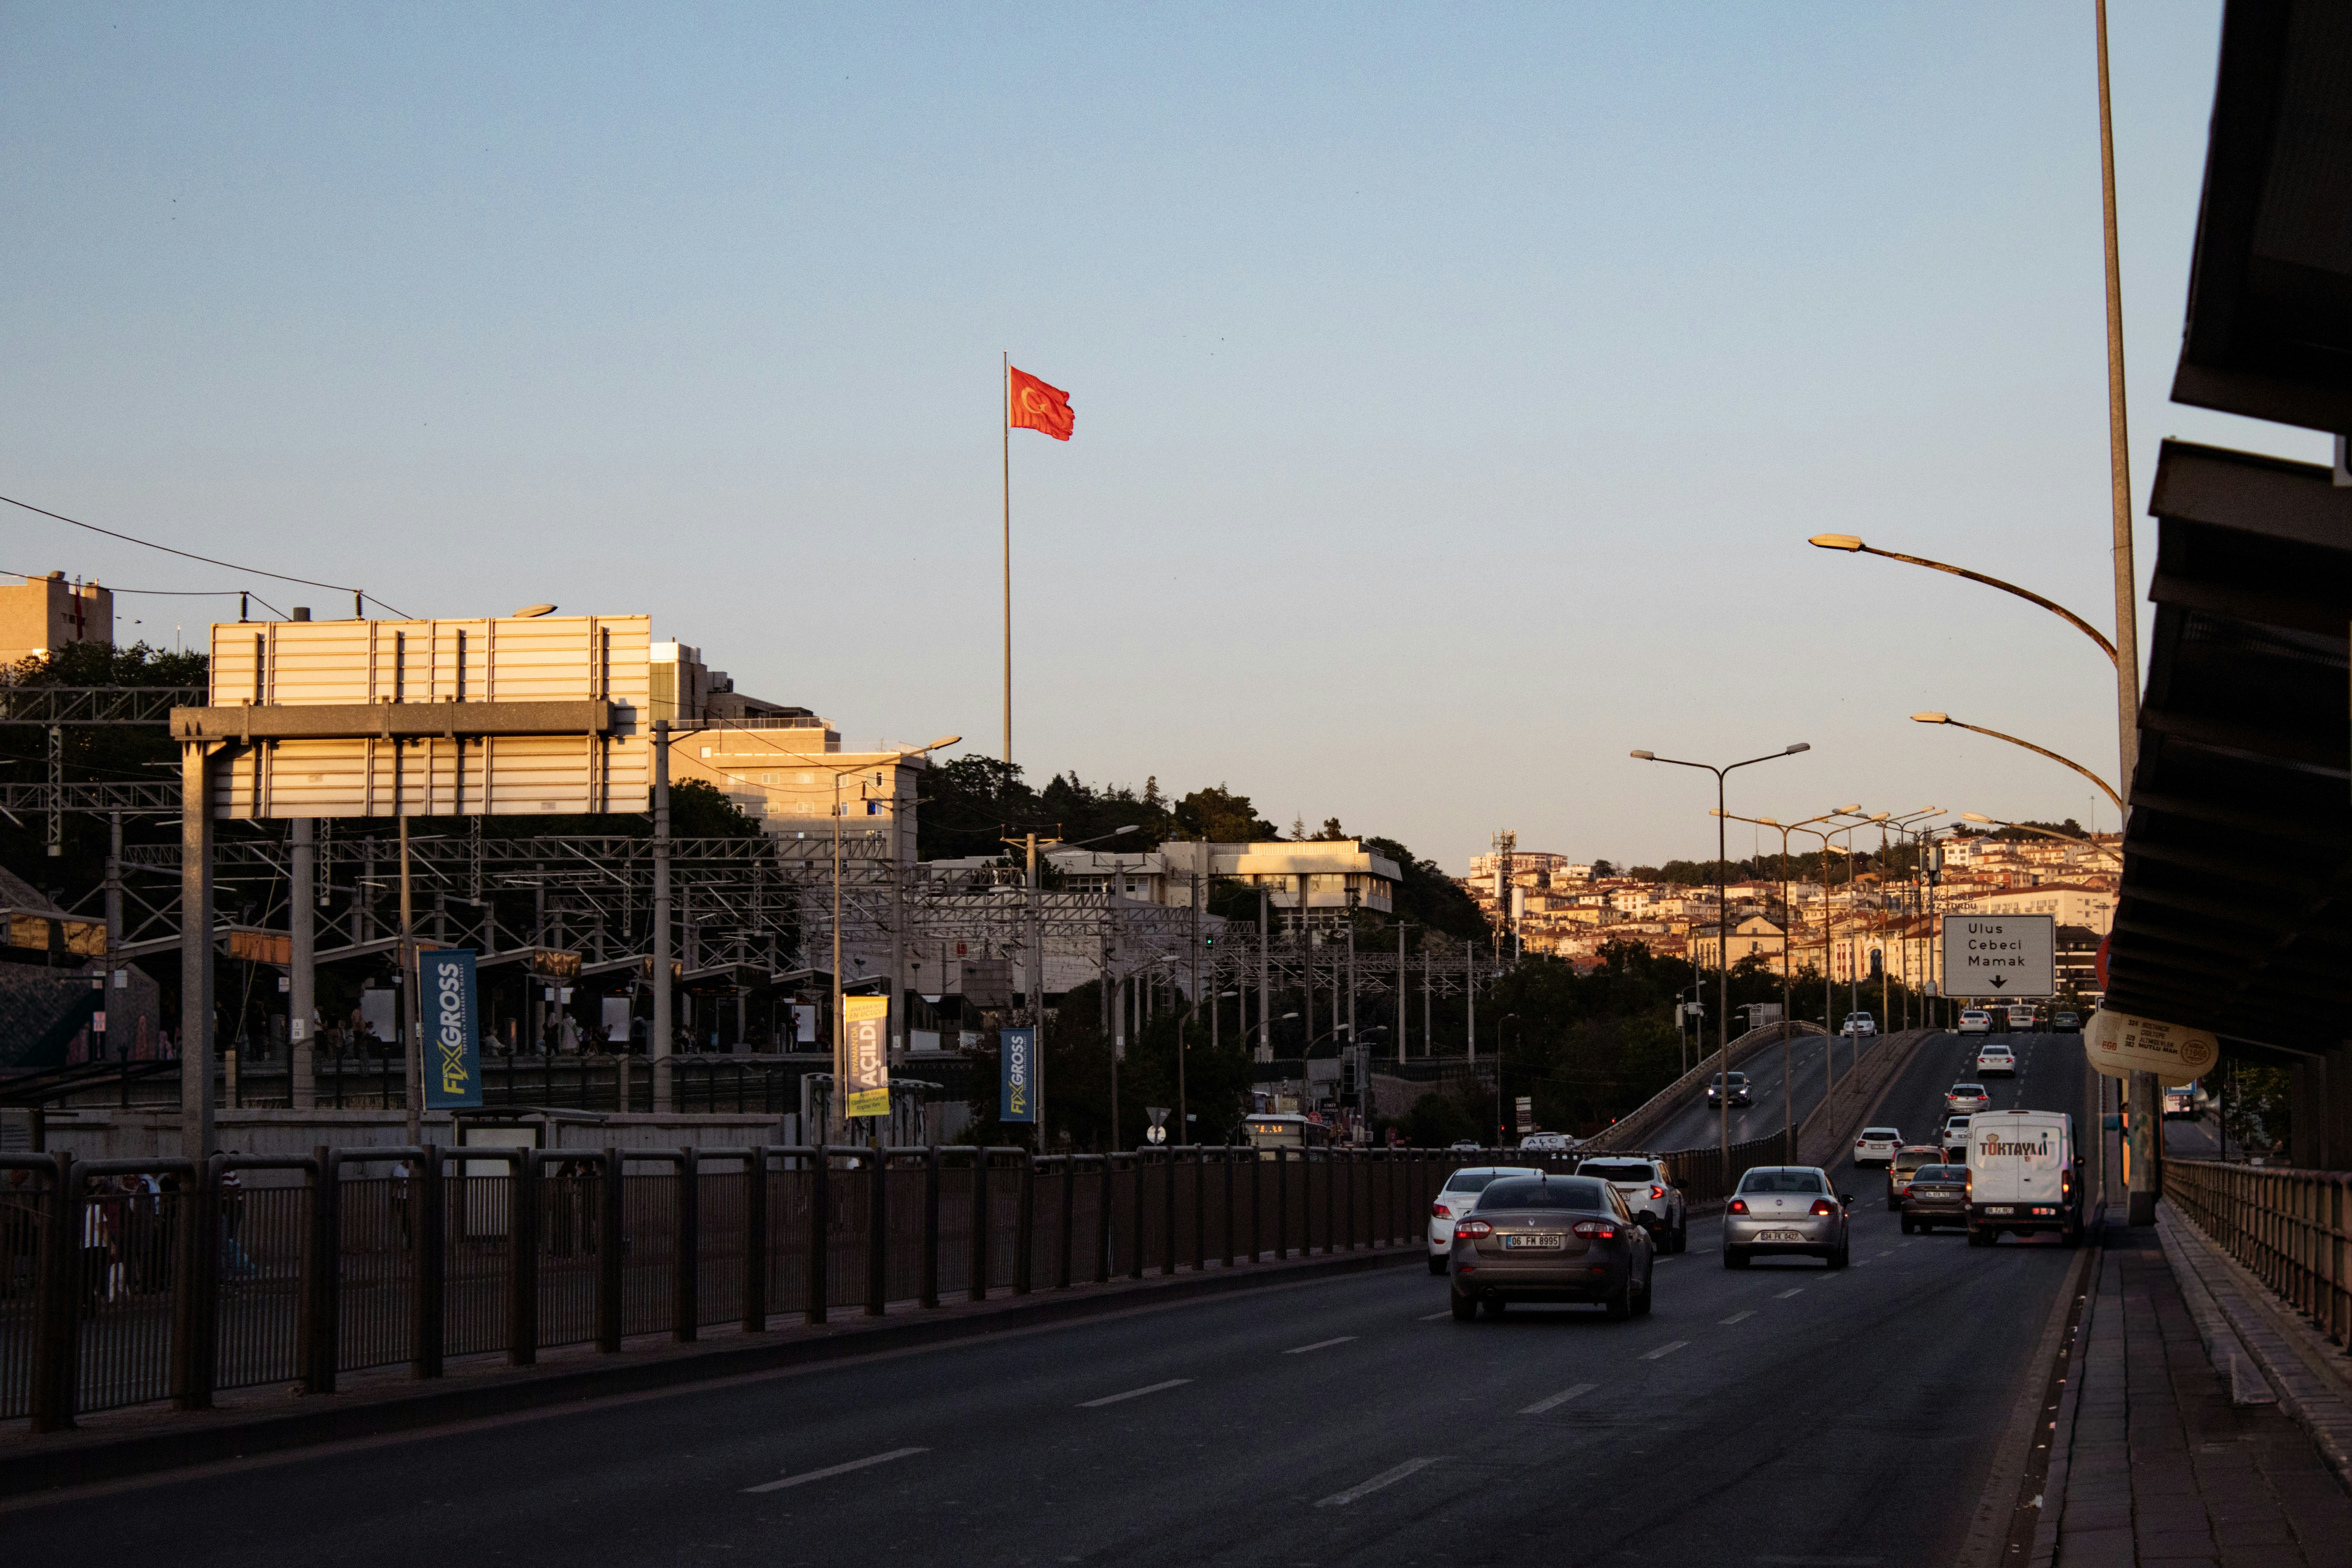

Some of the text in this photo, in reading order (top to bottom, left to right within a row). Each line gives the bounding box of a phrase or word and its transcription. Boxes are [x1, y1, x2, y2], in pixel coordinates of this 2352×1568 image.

[1969, 923, 2002, 934] Ulus
[1969, 939, 2021, 949] Cebeci
[1969, 955, 2025, 966] Mamak
[860, 1008, 884, 1017] UCUZU
[2102, 1041, 2117, 1051] EGO
[2138, 1043, 2161, 1051] MUTLU
[859, 1020, 881, 1086] AÇILDI
[1512, 1237, 1558, 1245] 06 FM 8995
